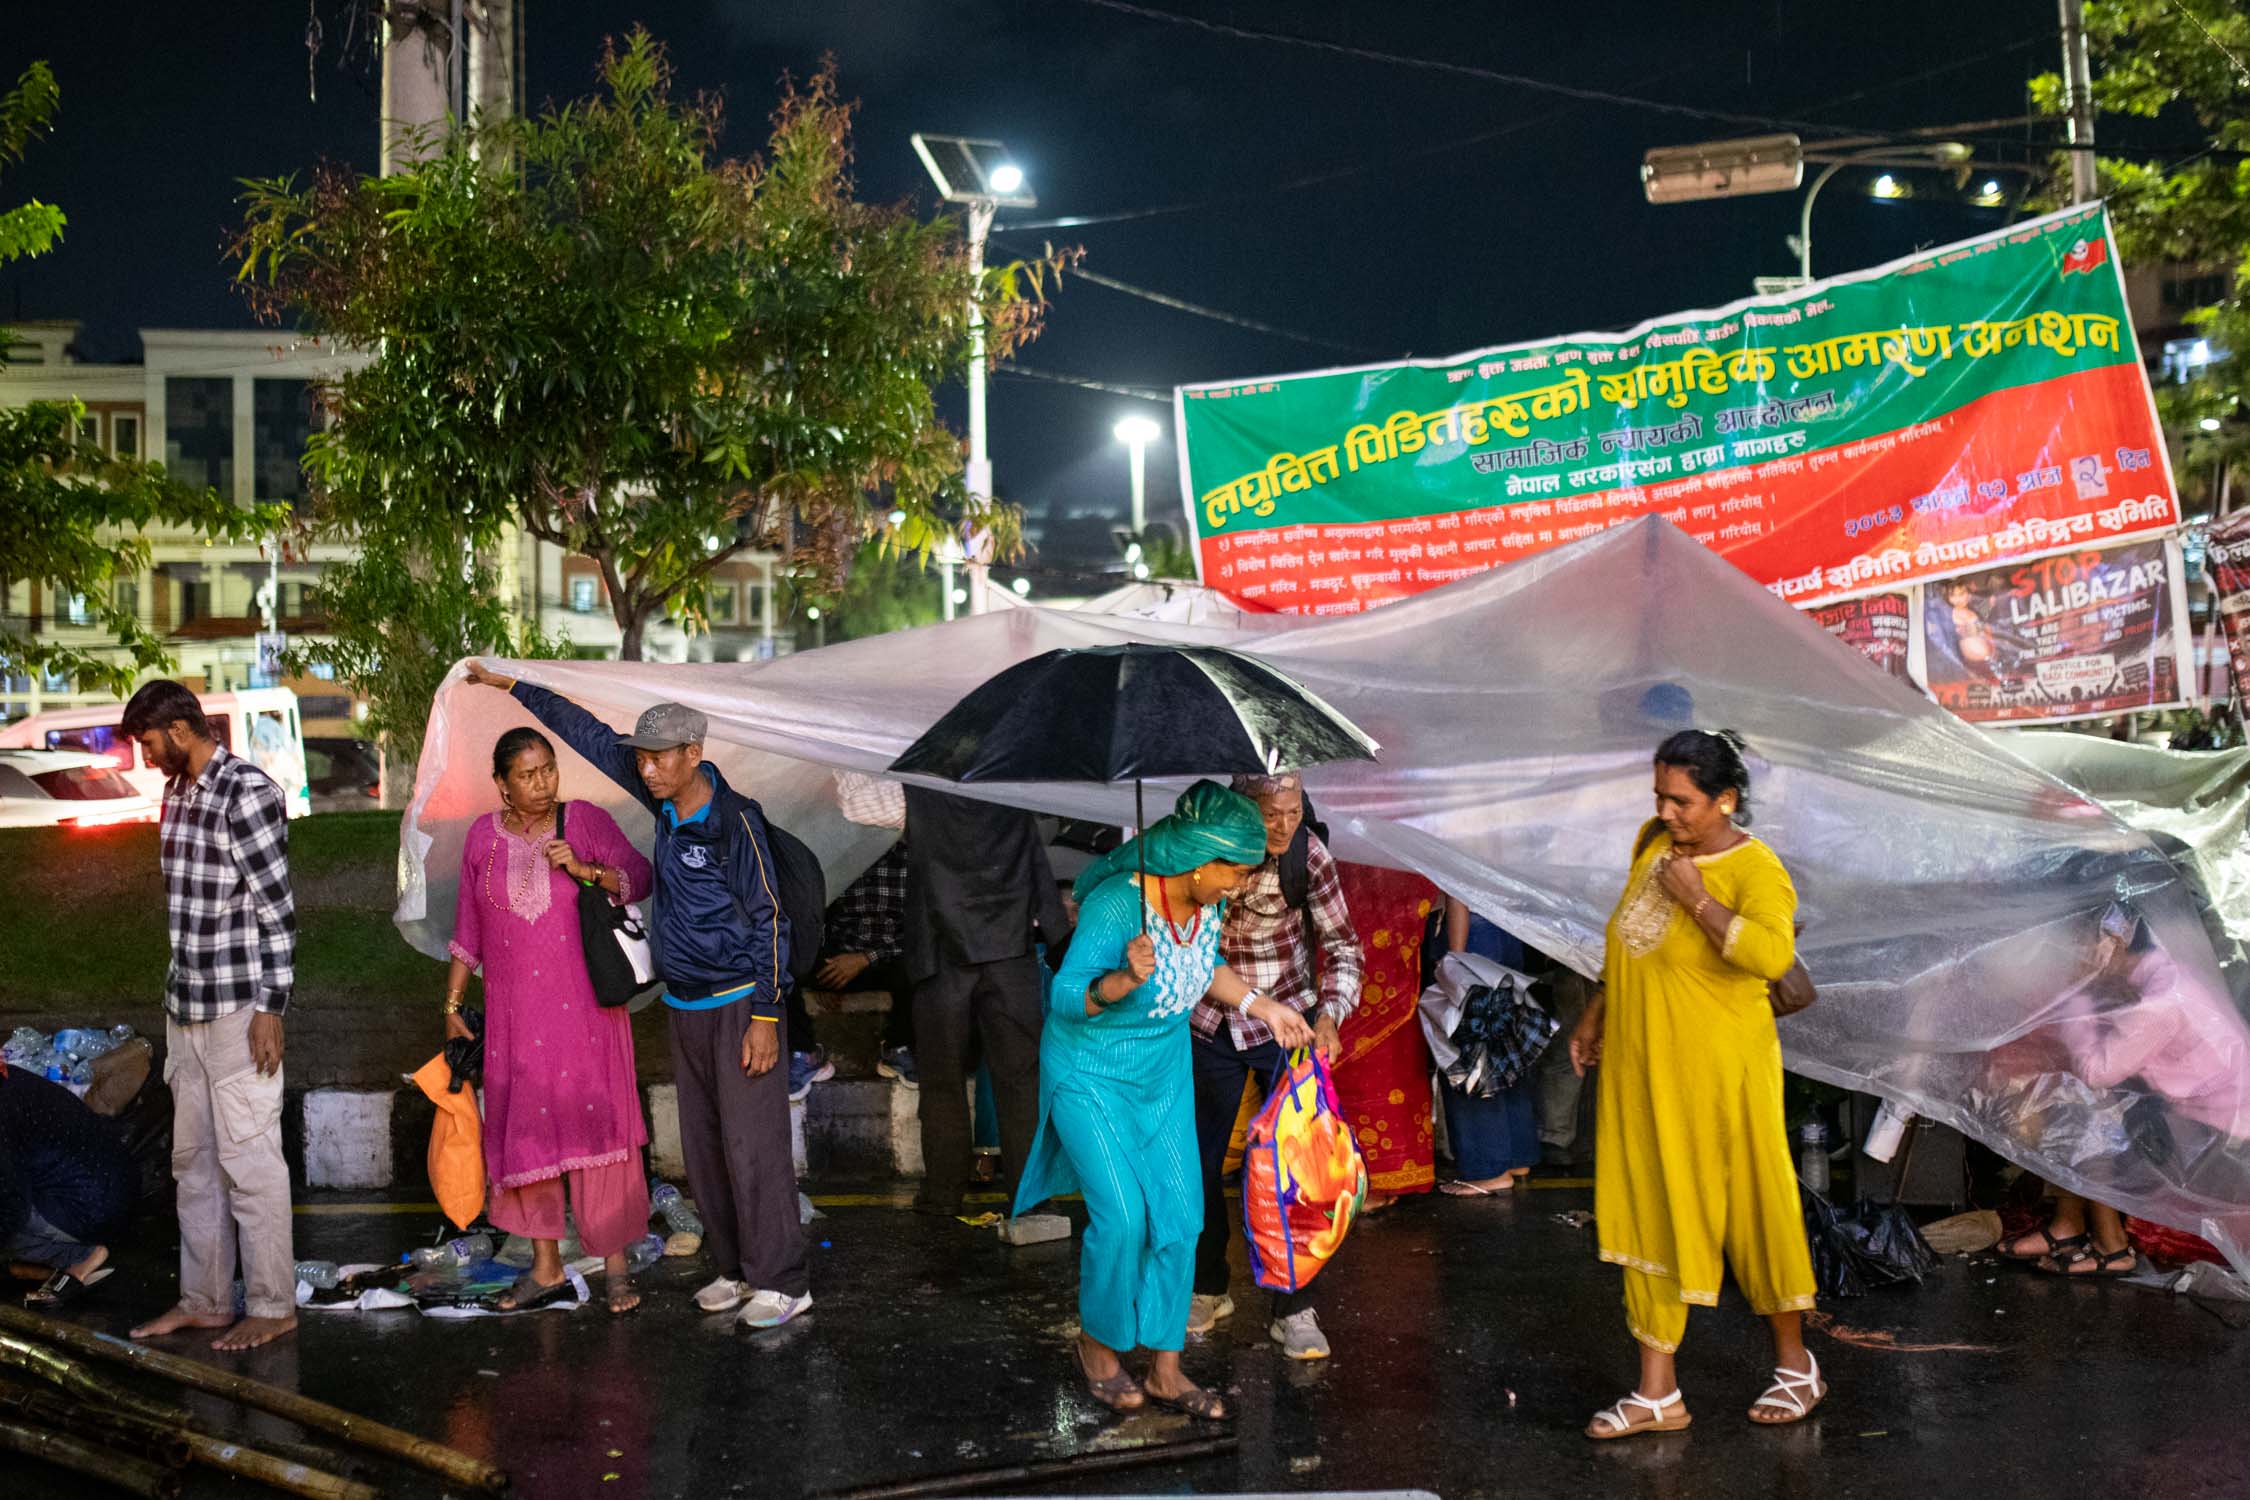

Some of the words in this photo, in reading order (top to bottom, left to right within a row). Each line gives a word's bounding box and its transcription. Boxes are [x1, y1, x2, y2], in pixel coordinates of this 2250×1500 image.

[1202, 444, 1341, 528] लघुवित्त
[1783, 325, 1952, 380] आमरण
[1958, 310, 2120, 359] अनशन
[1470, 437, 1590, 474] सामाजिक
[1598, 411, 1703, 456] न्यायको
[1504, 472, 1560, 497] नेपाल
[1680, 444, 1725, 472] हाम्रा
[2017, 466, 2063, 492] आज
[2117, 446, 2151, 472] दिन
[1826, 549, 1912, 588] समिति
[1915, 534, 1990, 566] नेपाल
[2097, 494, 2169, 530] समिति
[2010, 551, 2103, 598] STOP
[2010, 559, 2167, 625] LALIBAZAR
